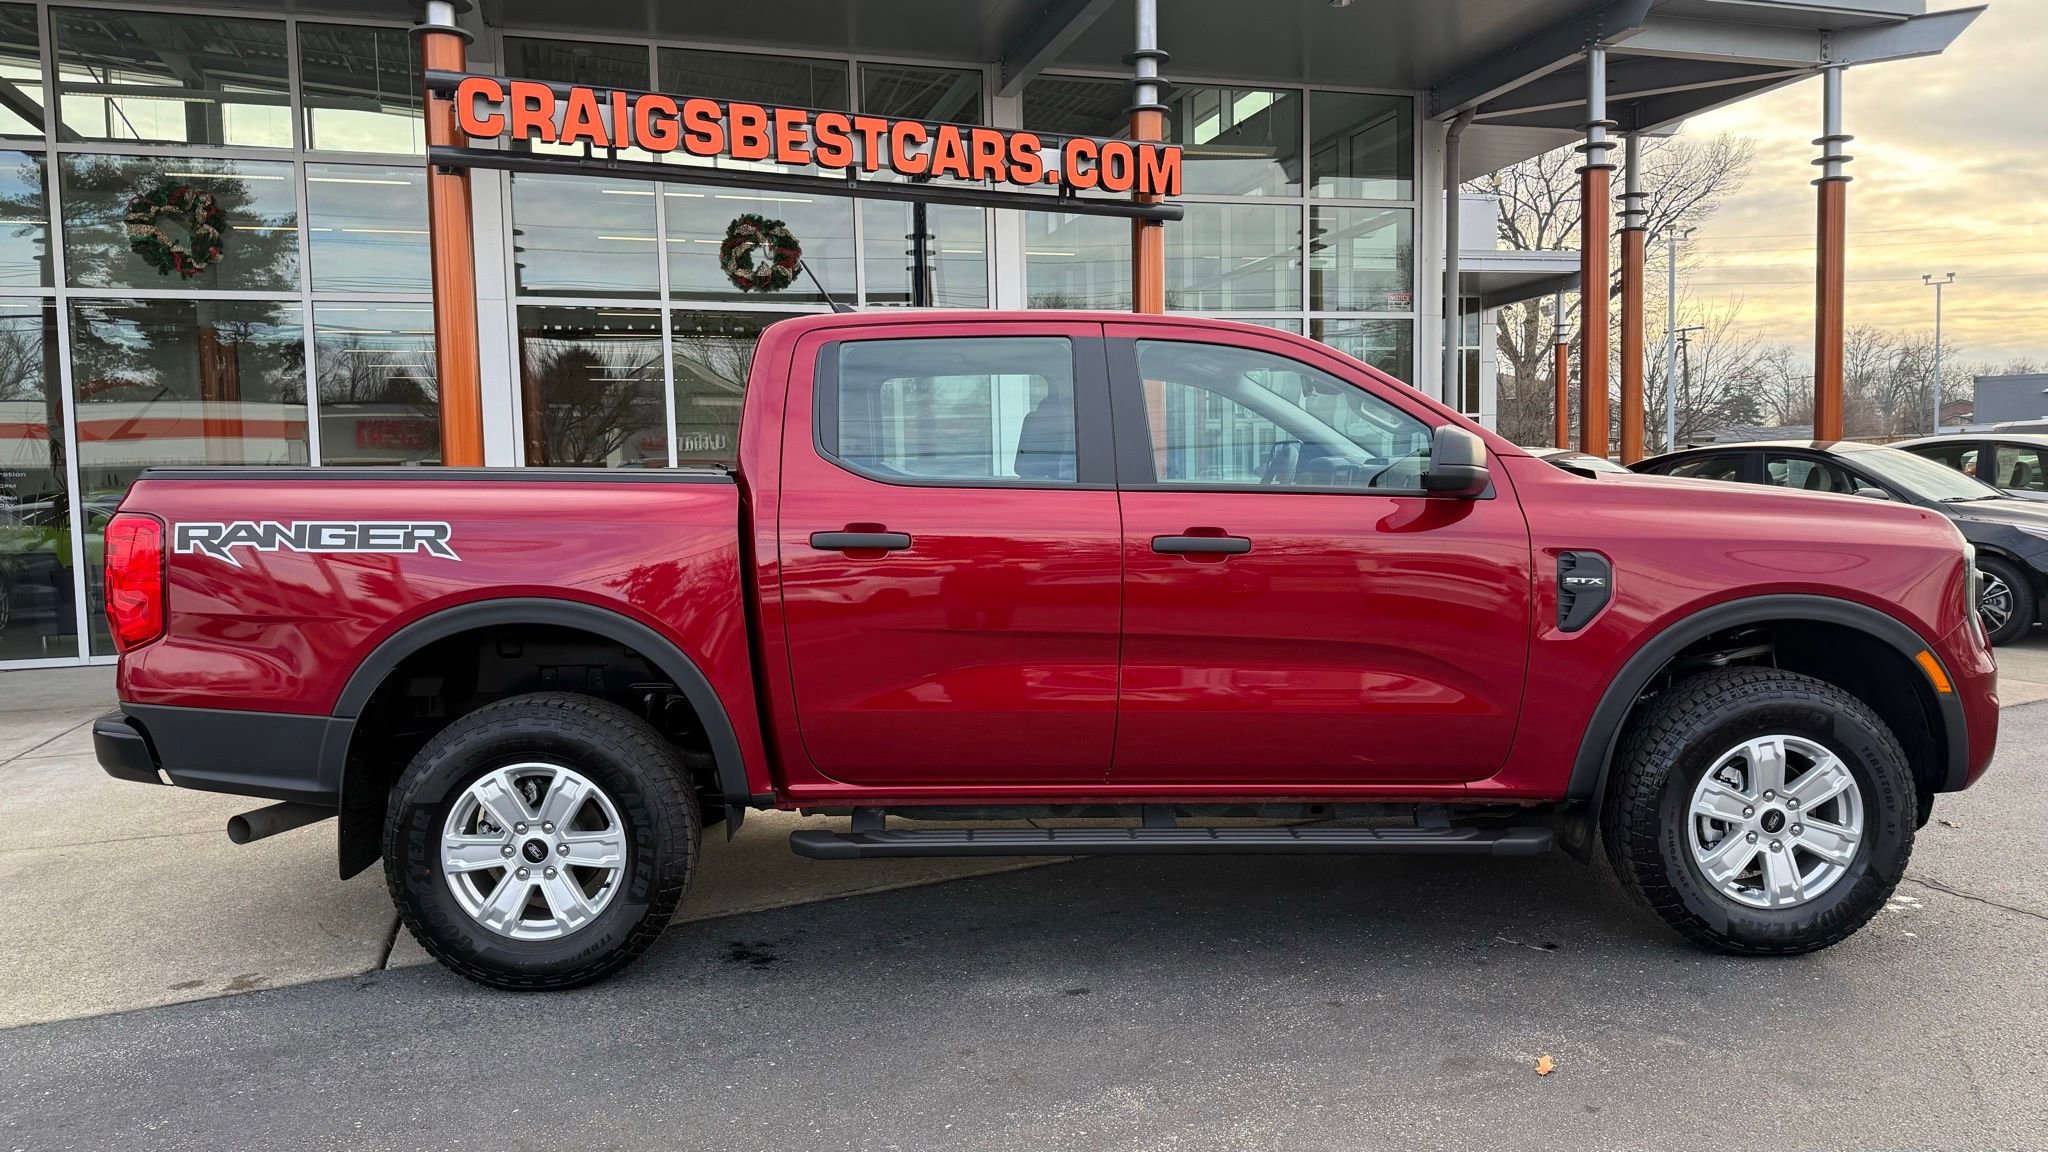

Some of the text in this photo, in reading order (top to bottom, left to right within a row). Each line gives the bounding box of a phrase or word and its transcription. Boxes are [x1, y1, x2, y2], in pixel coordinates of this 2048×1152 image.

[457, 77, 1182, 196] CRAIGSBESTCARS.COM
[173, 519, 462, 568] RANGER
[1565, 576, 1603, 585] STX
